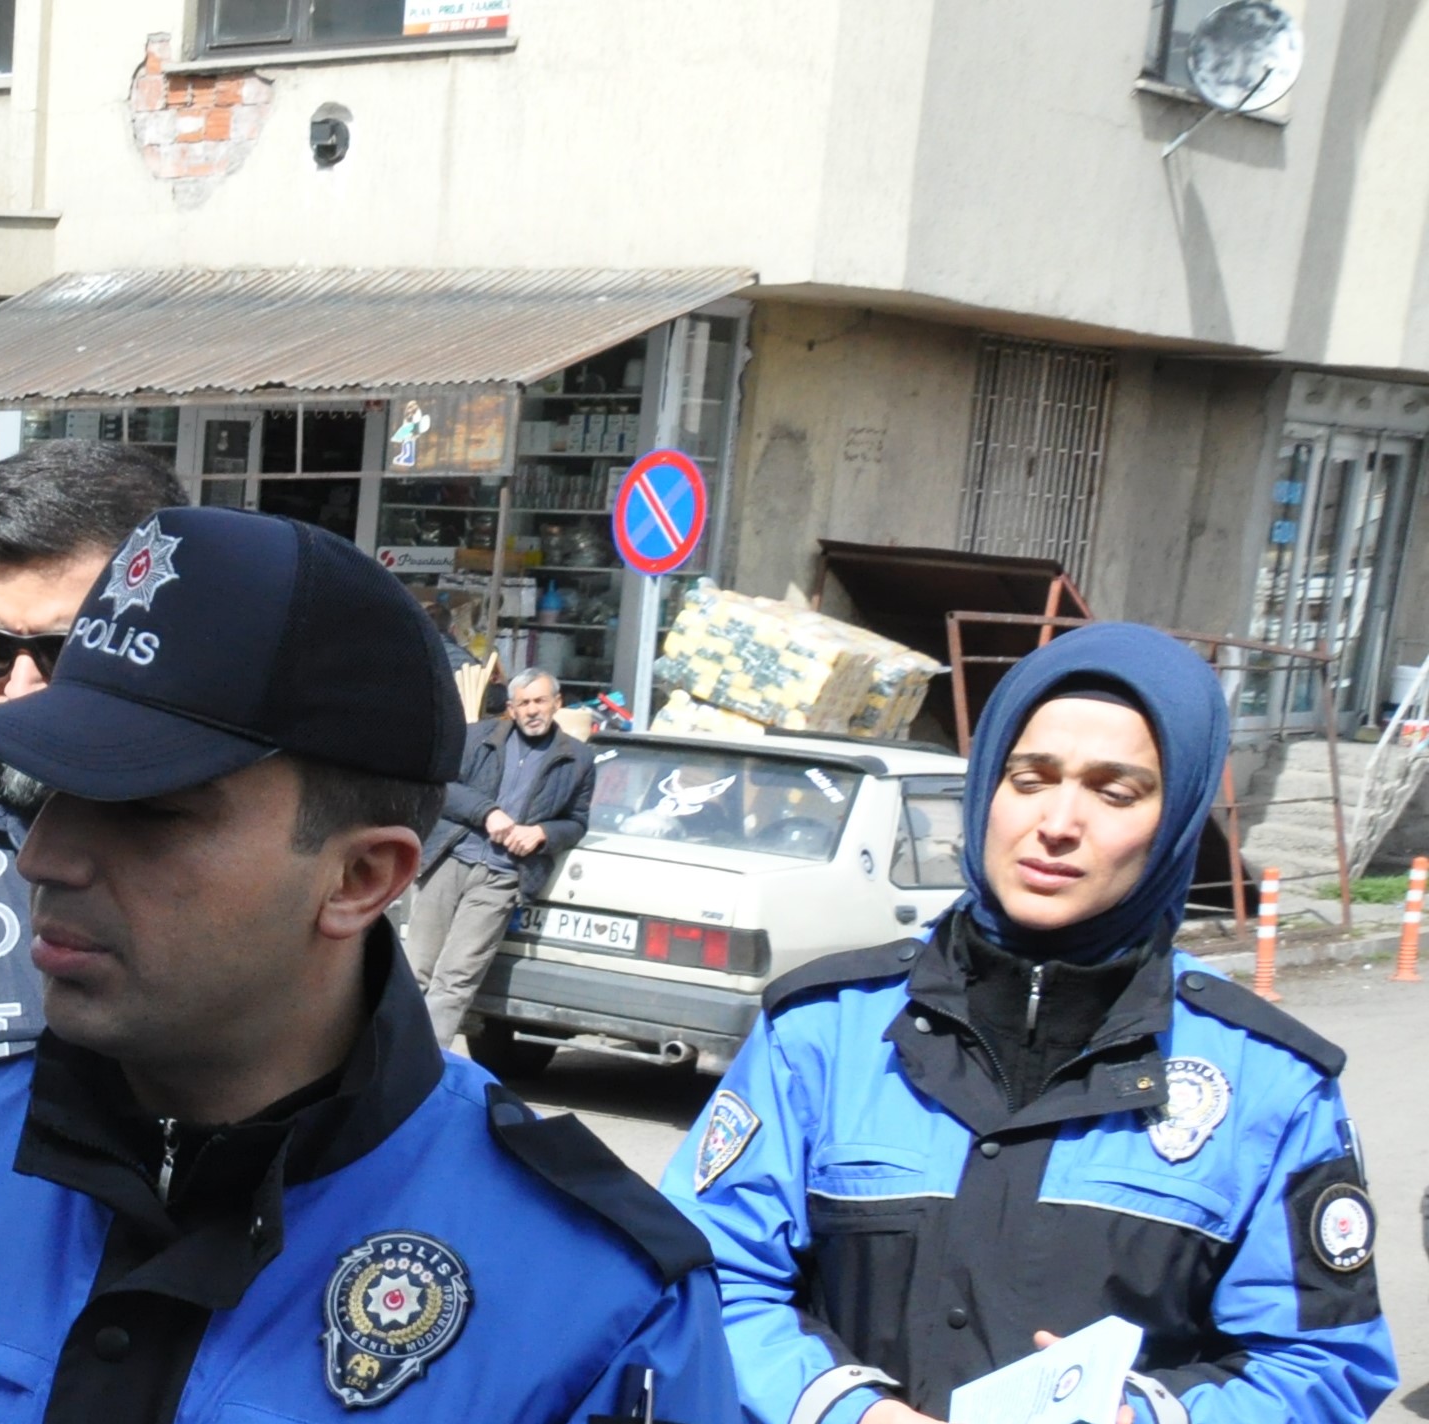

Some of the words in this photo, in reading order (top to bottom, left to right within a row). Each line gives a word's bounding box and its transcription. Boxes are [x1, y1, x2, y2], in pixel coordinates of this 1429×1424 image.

[519, 906, 542, 931] 34
[557, 915, 592, 940] PYA
[608, 920, 632, 946] 64
[380, 1242, 451, 1276] POLİS
